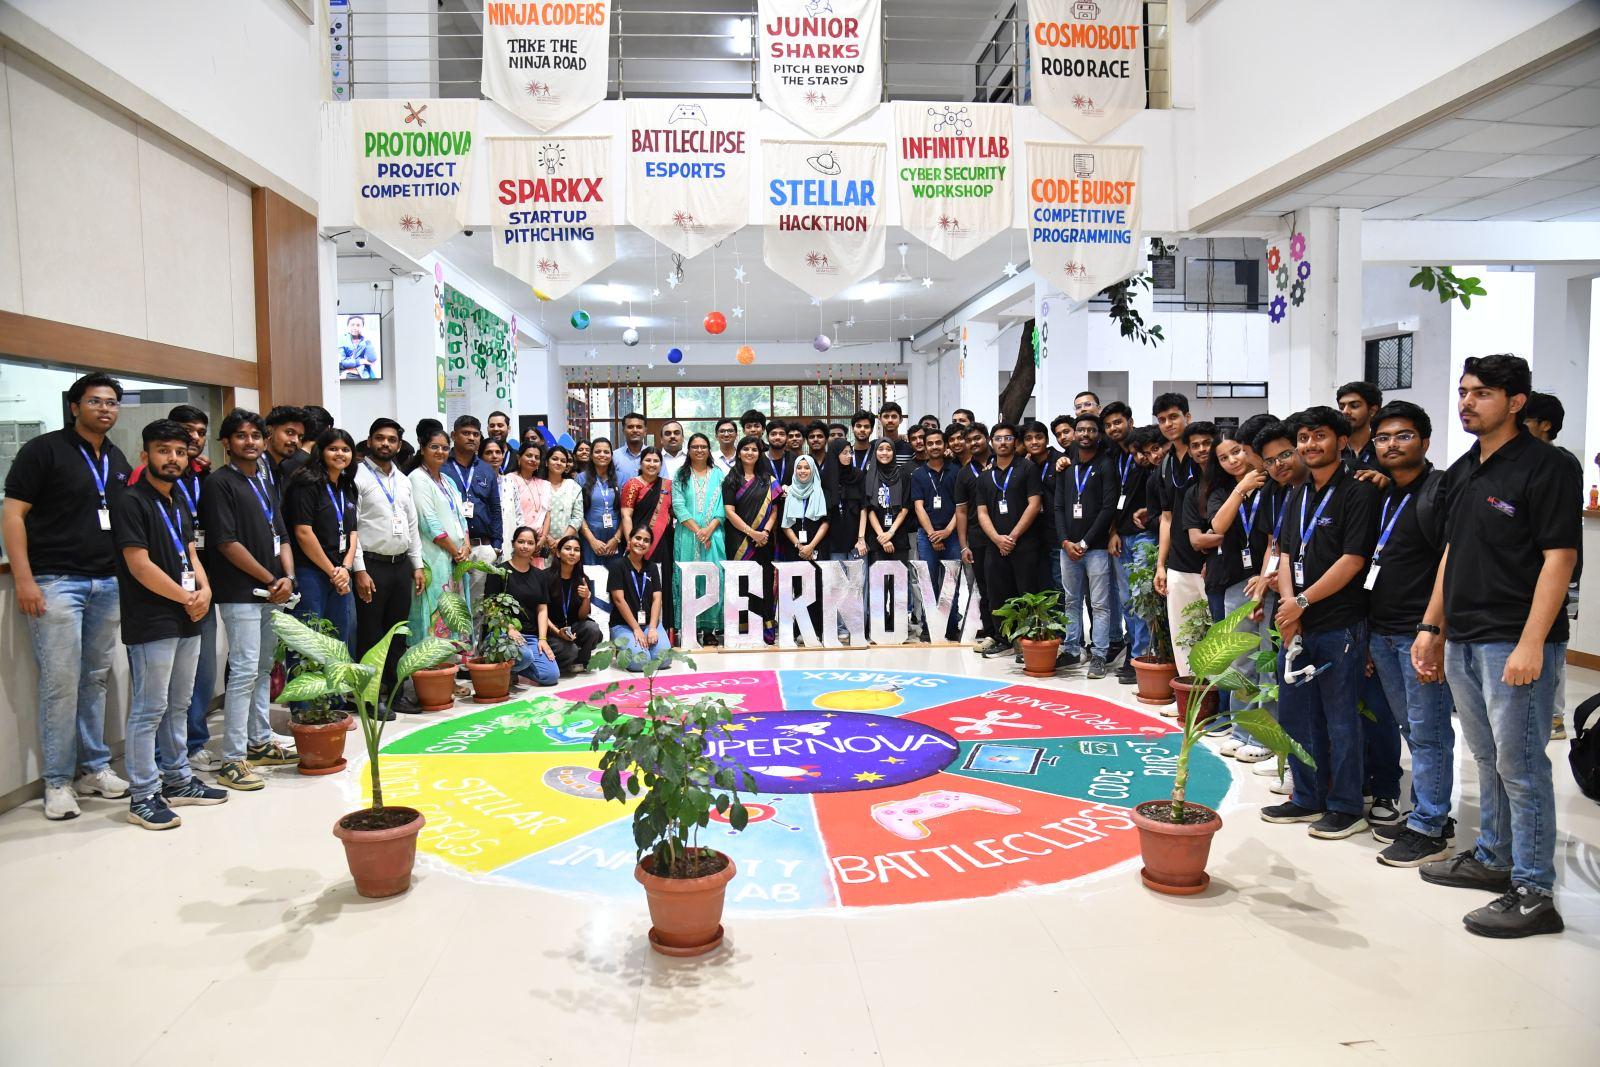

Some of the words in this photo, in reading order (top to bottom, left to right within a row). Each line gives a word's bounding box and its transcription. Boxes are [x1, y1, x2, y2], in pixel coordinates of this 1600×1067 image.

[488, 3, 540, 26] NINJA
[541, 3, 605, 26] CODERS
[766, 16, 859, 38] JUNIOR
[1035, 23, 1139, 50] COSMOBOLT
[508, 39, 546, 53] TAKE
[550, 39, 577, 54] THE
[771, 42, 860, 58] SHARKS
[509, 56, 550, 69] NINJA
[554, 56, 587, 71] ROAD
[773, 64, 810, 74] PITCH
[815, 64, 865, 74] BEYOND
[781, 76, 804, 86] THE
[807, 76, 848, 86] STARS
[365, 131, 471, 158] PROTONOVA
[632, 130, 746, 154] BATTLECLIPSE
[902, 137, 977, 159] INFINITY
[979, 136, 1009, 158] LAB
[377, 162, 457, 178] PROJECT
[646, 162, 726, 179] ESPORTS
[901, 167, 942, 182] CYBER
[945, 166, 1006, 181] SECURITY
[361, 182, 462, 199] COMPETITION
[498, 178, 604, 206] SPARKX
[770, 179, 876, 207] STELLAR
[912, 184, 994, 198] WORKSHOP
[1032, 179, 1080, 204] CODE
[1082, 181, 1135, 206] BURST
[509, 210, 587, 226] STARTUP
[779, 215, 867, 232] HACKTHON
[1034, 209, 1126, 224] COMPETITIVE
[504, 227, 594, 245] PITHCHING
[1033, 228, 1131, 245] PROGRAMMING
[802, 671, 948, 688] SPARKX
[979, 691, 1131, 730] PROTONOVA
[1087, 768, 1135, 799] CODE
[432, 777, 568, 837] STELLAR
